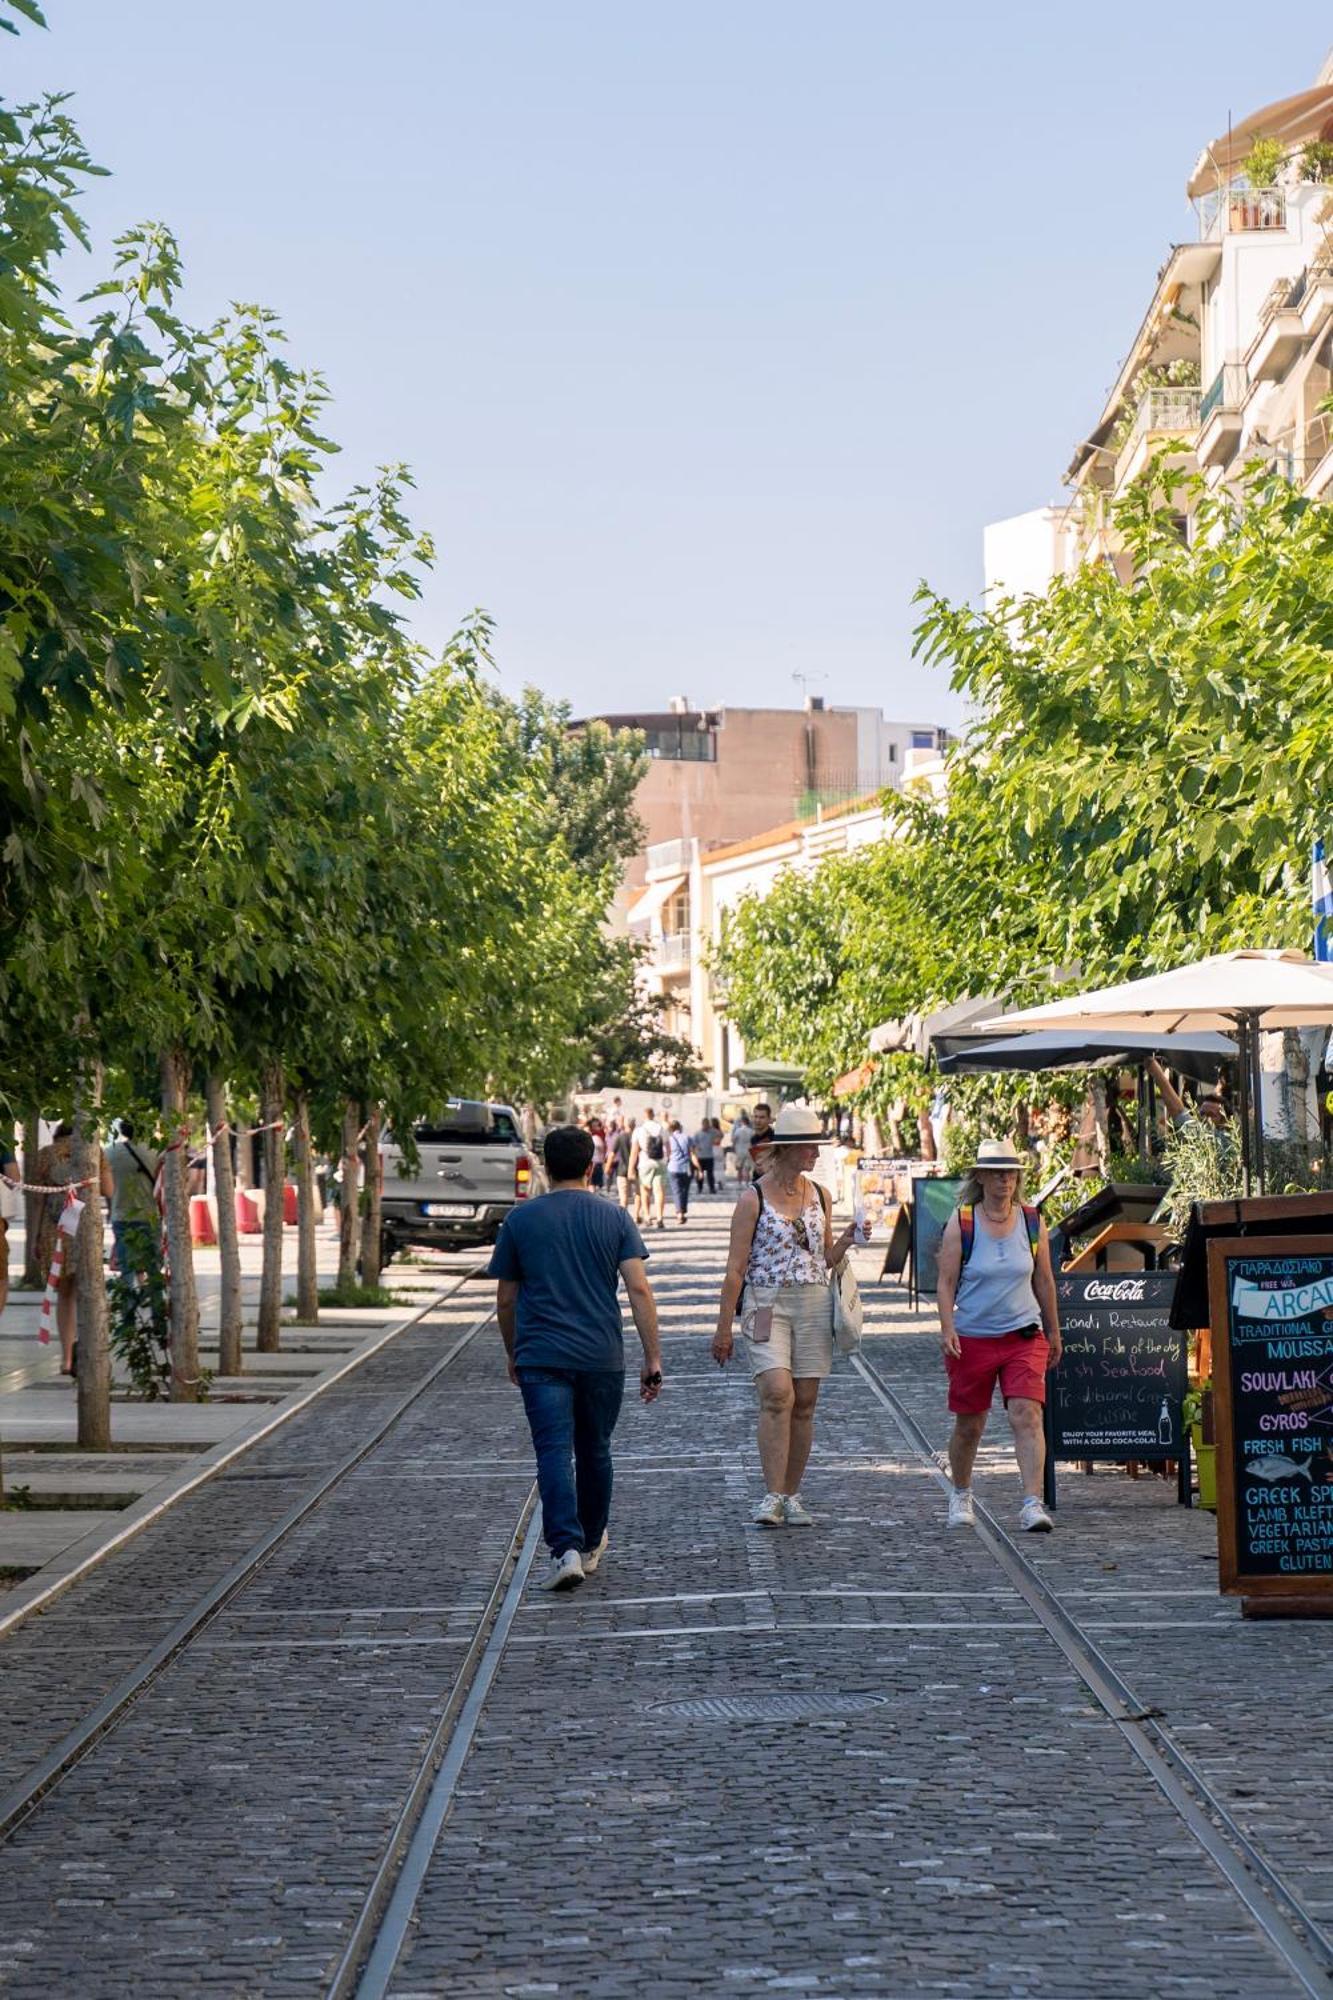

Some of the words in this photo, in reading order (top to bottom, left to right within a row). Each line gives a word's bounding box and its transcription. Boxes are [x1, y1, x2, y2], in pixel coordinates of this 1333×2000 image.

[1084, 1279, 1147, 1300] Coca-Cola
[1238, 1322, 1315, 1338] TRADITIONAL
[1061, 1336, 1097, 1354] resh
[1144, 1337, 1161, 1354] the
[1100, 1354, 1167, 1378] Seafood
[1241, 1370, 1317, 1392] SOUVLAKI
[1259, 1411, 1308, 1431] GYROS
[1244, 1439, 1285, 1455] FRESH
[1292, 1437, 1322, 1453] FISH
[1245, 1486, 1300, 1505] GREEK
[1247, 1507, 1287, 1522] LAMB
[1249, 1540, 1290, 1554] GREEK
[1280, 1554, 1332, 1570] GLUTEN
